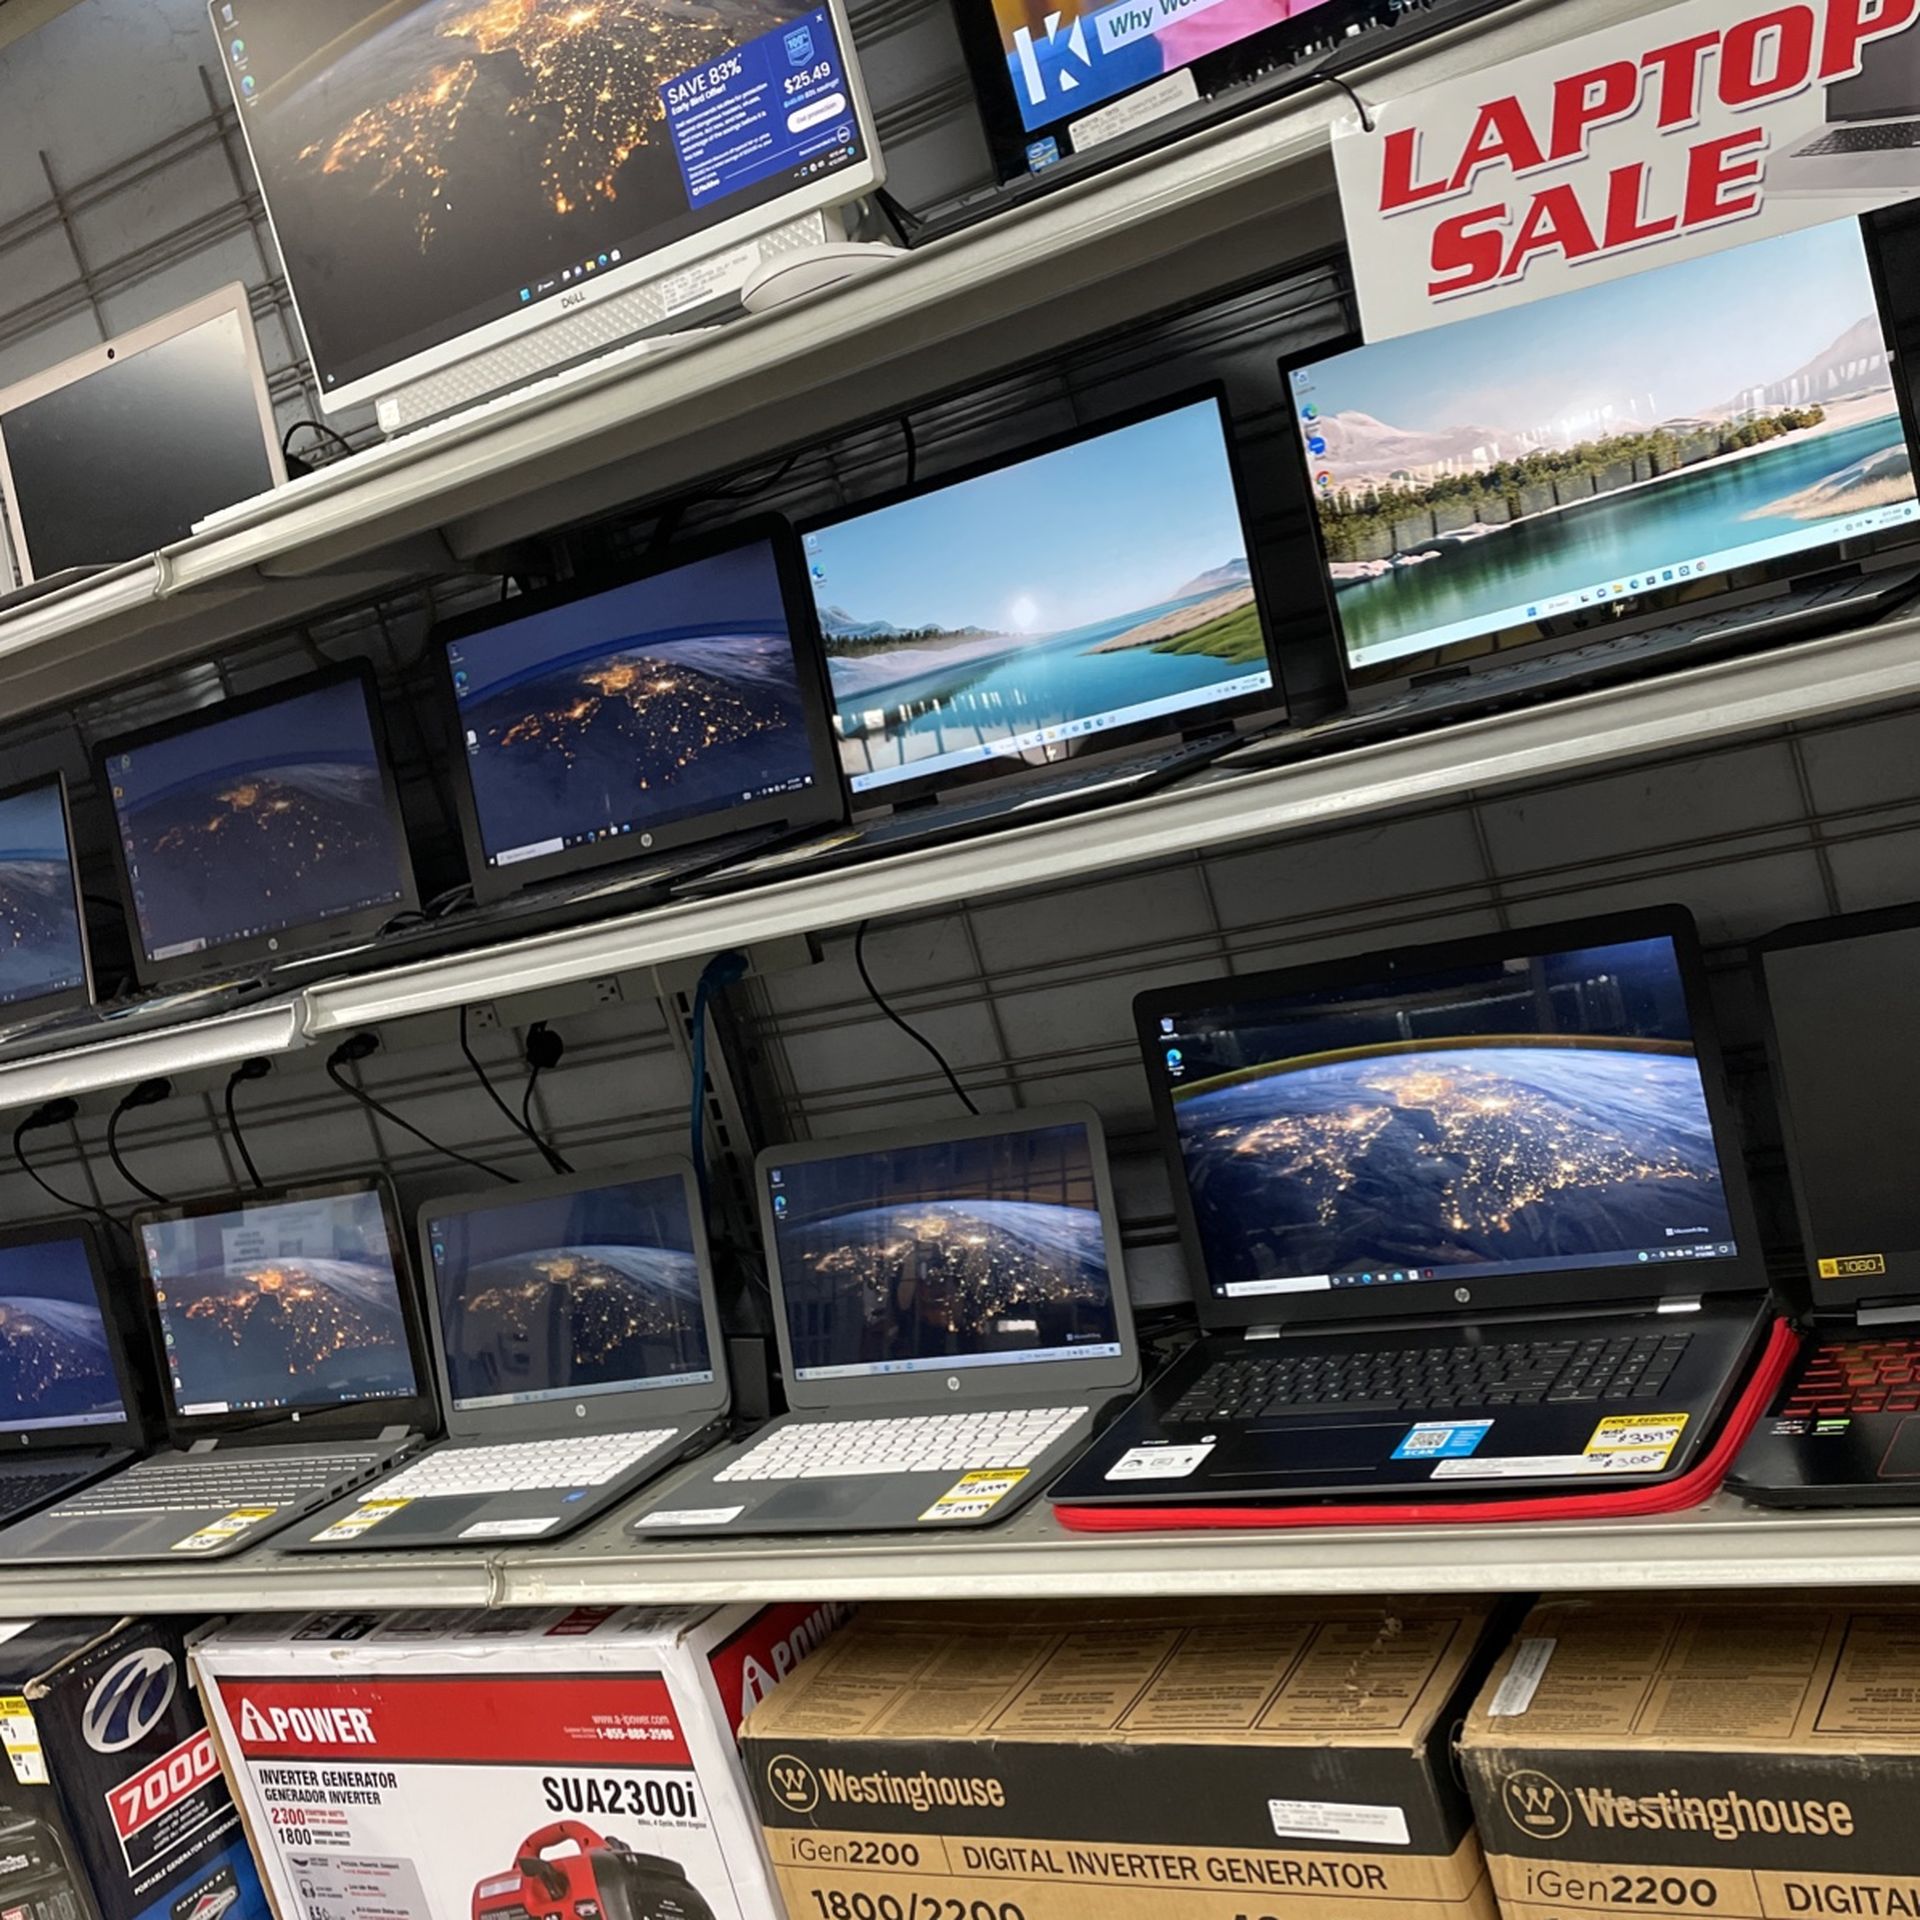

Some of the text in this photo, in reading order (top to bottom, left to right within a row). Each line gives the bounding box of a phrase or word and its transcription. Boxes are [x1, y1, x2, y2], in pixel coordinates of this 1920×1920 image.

[1109, 7, 1154, 38] Why
[667, 73, 706, 105] SAVE
[783, 61, 832, 95] $25.49
[671, 102, 690, 116] Early
[690, 93, 706, 107] Bird
[1380, 0, 1916, 212] LAPTOP
[1428, 127, 1763, 298] SALE
[1600, 1428, 1626, 1438] WAS
[1603, 1414, 1687, 1426] PRICE REDUCED
[1402, 1449, 1437, 1457] SCAN
[1588, 1452, 1614, 1462] NOW
[119, 1736, 217, 1826] 7000
[259, 1768, 398, 1789] INVERTER GENERATOR
[819, 1767, 1006, 1810] Westinghouse
[265, 1788, 381, 1806] GENERADOR INVERTER
[541, 1776, 698, 1819] SUA2300i
[271, 1807, 306, 1826] 2300
[1574, 1786, 1855, 1843] Westinghouse
[277, 1828, 312, 1846] 1800
[133, 1866, 168, 1896] PORTABLE
[167, 1841, 205, 1874] GENERATOR
[790, 1835, 1387, 1891] iGen2200 DIGITAL INVERTER GENERATOR
[1526, 1869, 1718, 1908] iGen2200
